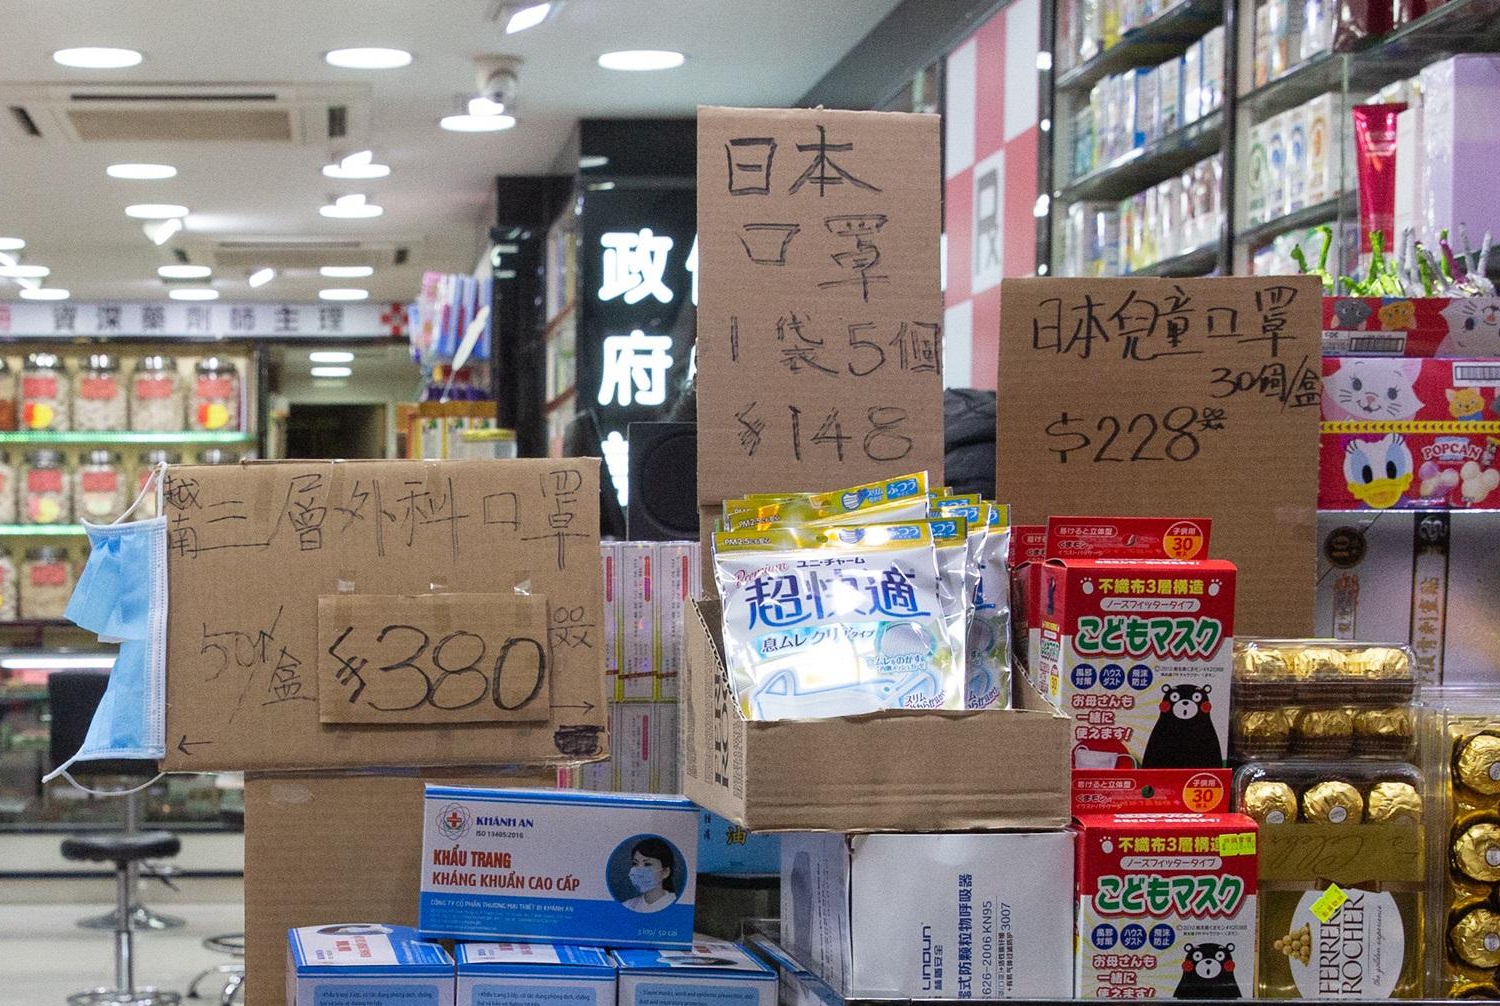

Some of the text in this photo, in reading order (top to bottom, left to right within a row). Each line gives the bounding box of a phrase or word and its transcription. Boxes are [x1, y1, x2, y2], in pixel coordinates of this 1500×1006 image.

[725, 124, 882, 196] 日本
[740, 214, 889, 303] 口罩
[1032, 285, 1297, 360] 日本兒童口罩
[736, 401, 912, 462] $148
[1045, 405, 1199, 463] $228
[1423, 442, 1482, 460] POPCAN
[888, 480, 916, 495] ふつう
[196, 470, 589, 570] 三層外科口罩
[1173, 538, 1192, 550] 30
[1099, 579, 1204, 594] 不織布3層構造
[1077, 618, 1221, 655] こどもマスク
[328, 625, 546, 711] $380
[1072, 695, 1133, 707] お母さんも
[1077, 712, 1113, 723] 一緒に
[1192, 790, 1213, 802] 30
[519, 818, 533, 828] AN
[434, 844, 511, 868] KHẨU TRANG
[433, 870, 579, 891] KHÁNG KHUẨN CAO CẤP
[1098, 878, 1241, 912] こどもマスク
[1001, 902, 1011, 930] 3007
[1374, 904, 1385, 946] experience
[982, 900, 992, 999] 626-2006 KN95
[1319, 908, 1341, 995] FERRER
[1342, 894, 1364, 995] ROCHER
[1093, 956, 1156, 968] お母さんも
[1373, 947, 1384, 973] golden
[1098, 972, 1134, 984] 一緒に
